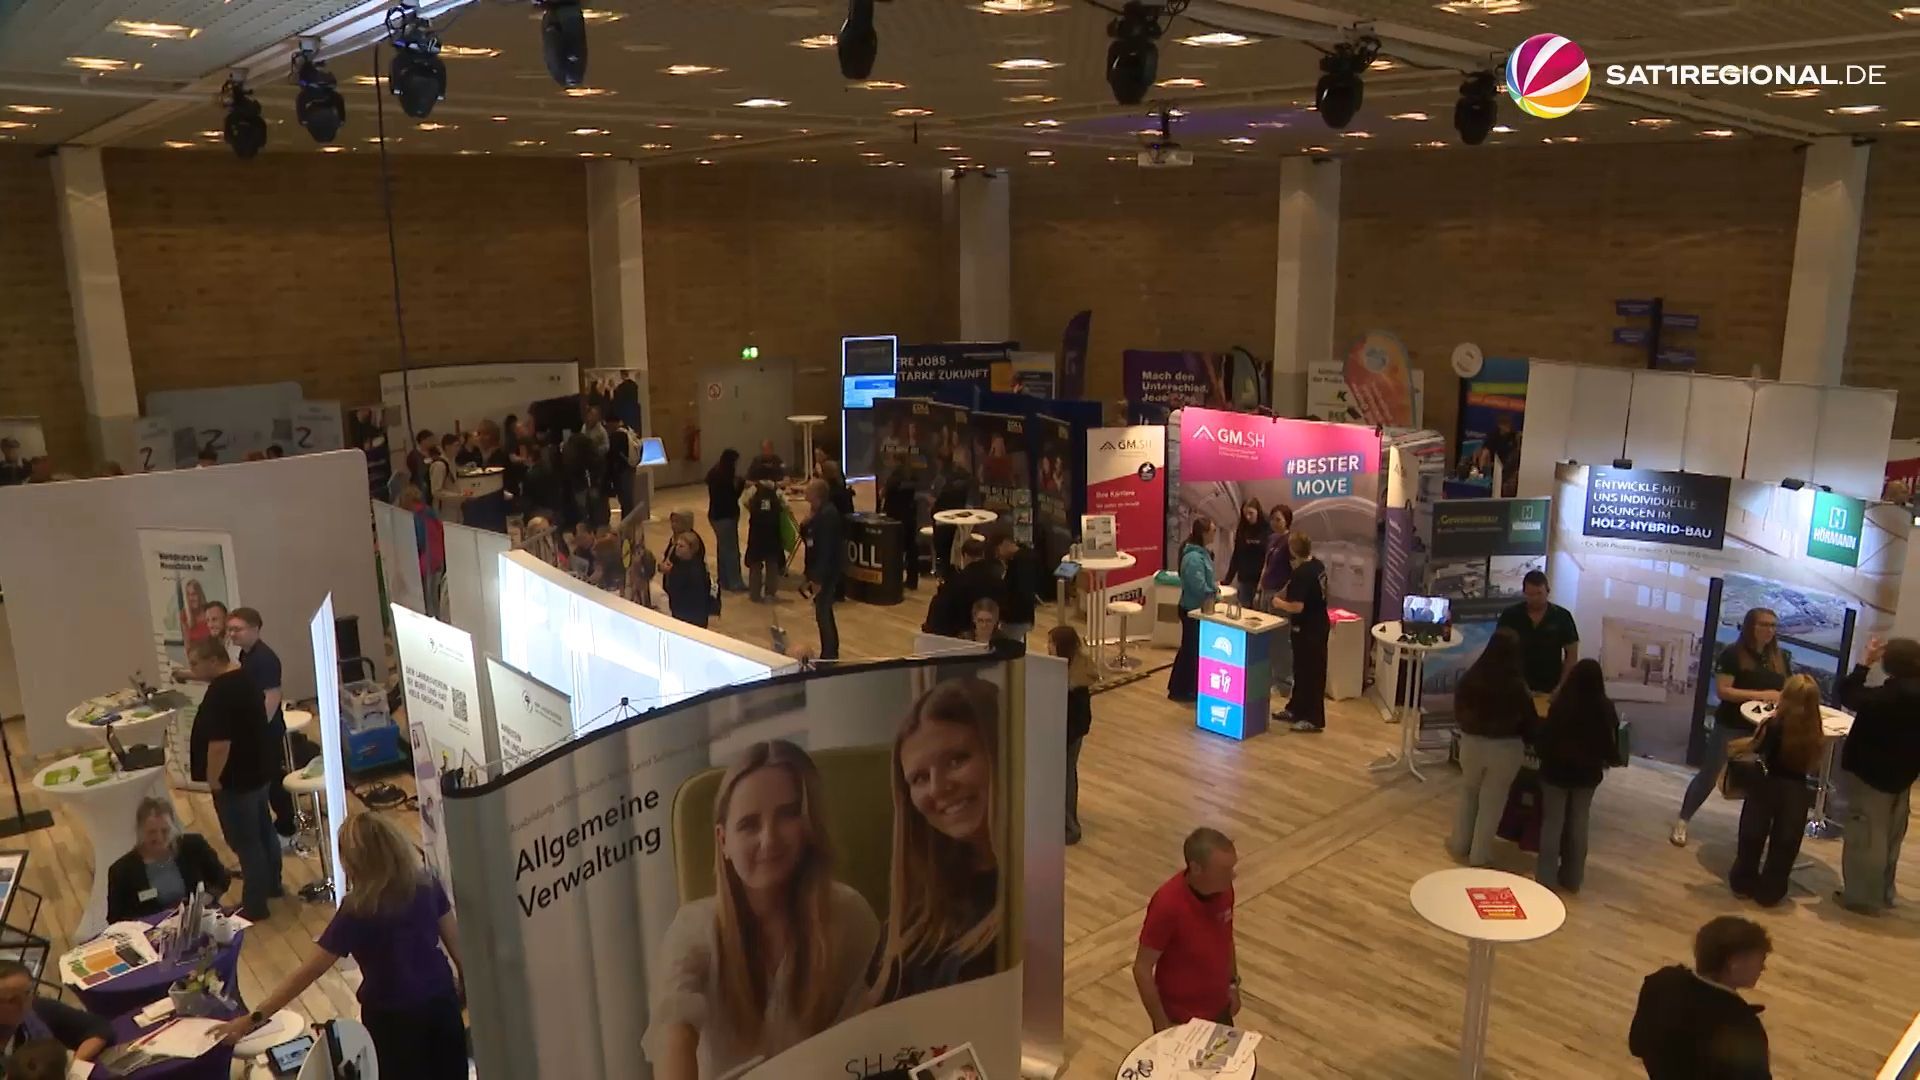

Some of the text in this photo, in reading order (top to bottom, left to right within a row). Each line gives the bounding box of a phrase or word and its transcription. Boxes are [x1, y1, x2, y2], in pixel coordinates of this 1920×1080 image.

[917, 356, 947, 367] JOBS
[939, 369, 989, 380] ZUKUNFT
[1142, 371, 1195, 380] Mach den
[1118, 440, 1152, 450] GM.SH
[1218, 428, 1265, 448] GM.SH
[1287, 455, 1359, 475] #BESTER
[1296, 478, 1347, 496] MOVE
[1594, 479, 1682, 495] ENTWICKLE MIT
[1593, 492, 1697, 510] UNS INDIVIDUELLE
[1592, 504, 1671, 519] LÖSUNGEN IM
[1591, 517, 1712, 538] HOLZ-HYBRID-BAU
[1813, 526, 1857, 550] HÖRMANN
[847, 540, 883, 568] OLL
[515, 789, 660, 882] Allgemeine
[517, 826, 661, 918] Verwaltung
